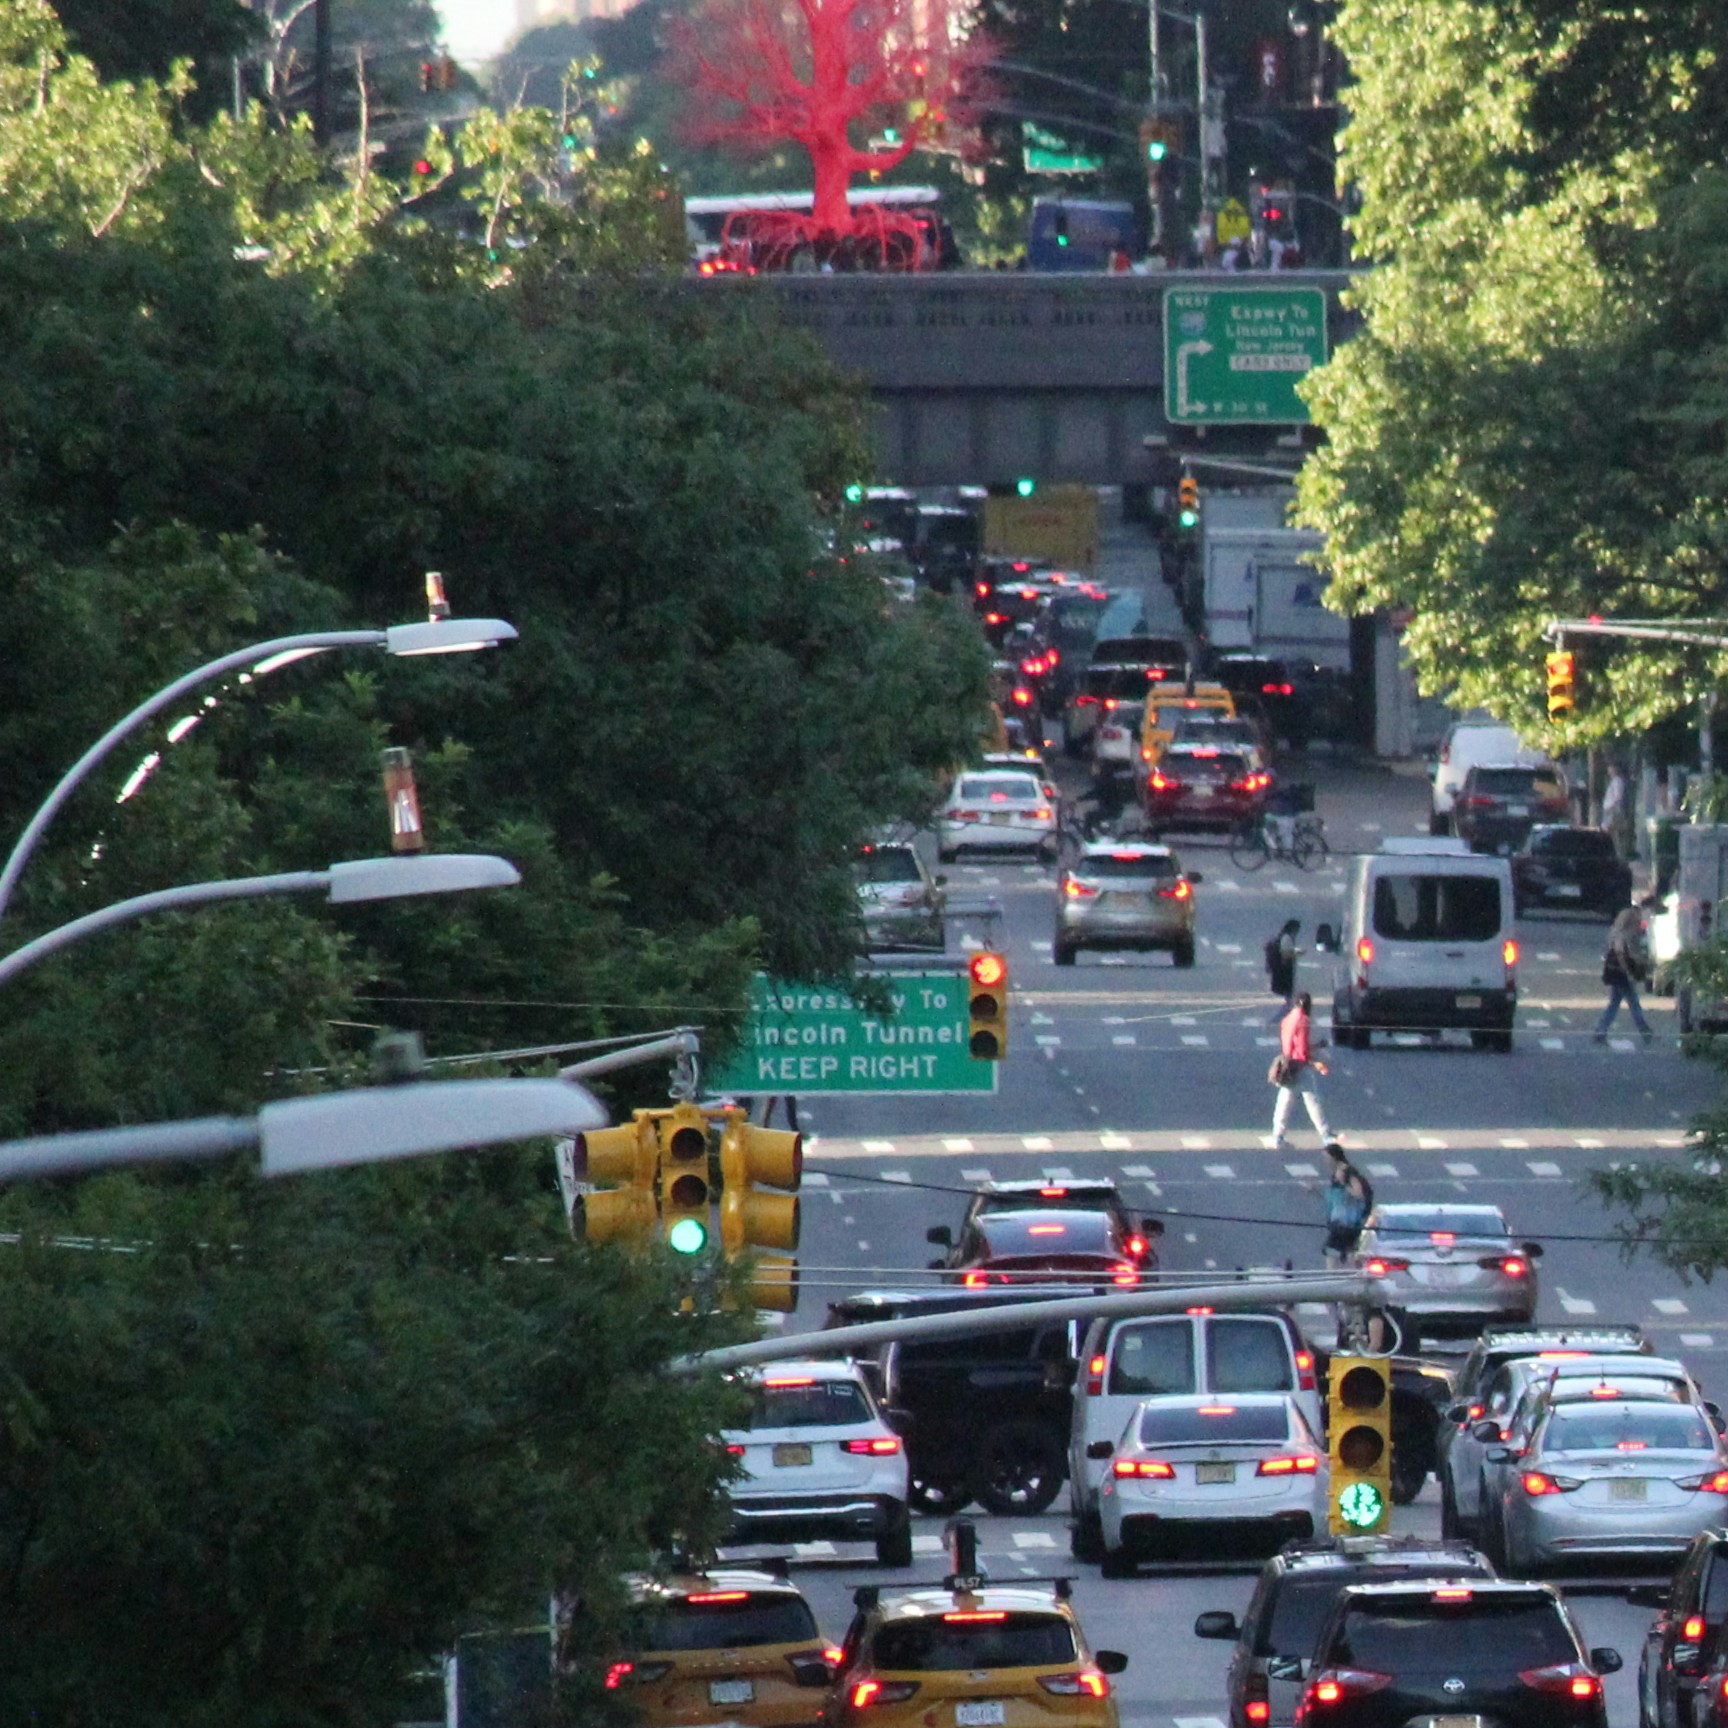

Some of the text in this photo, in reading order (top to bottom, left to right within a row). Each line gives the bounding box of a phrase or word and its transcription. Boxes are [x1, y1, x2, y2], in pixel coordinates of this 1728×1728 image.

[920, 990, 948, 1009] To
[752, 1022, 963, 1045] incoln Tunnel
[758, 1055, 938, 1080] KEEP RIGHT
